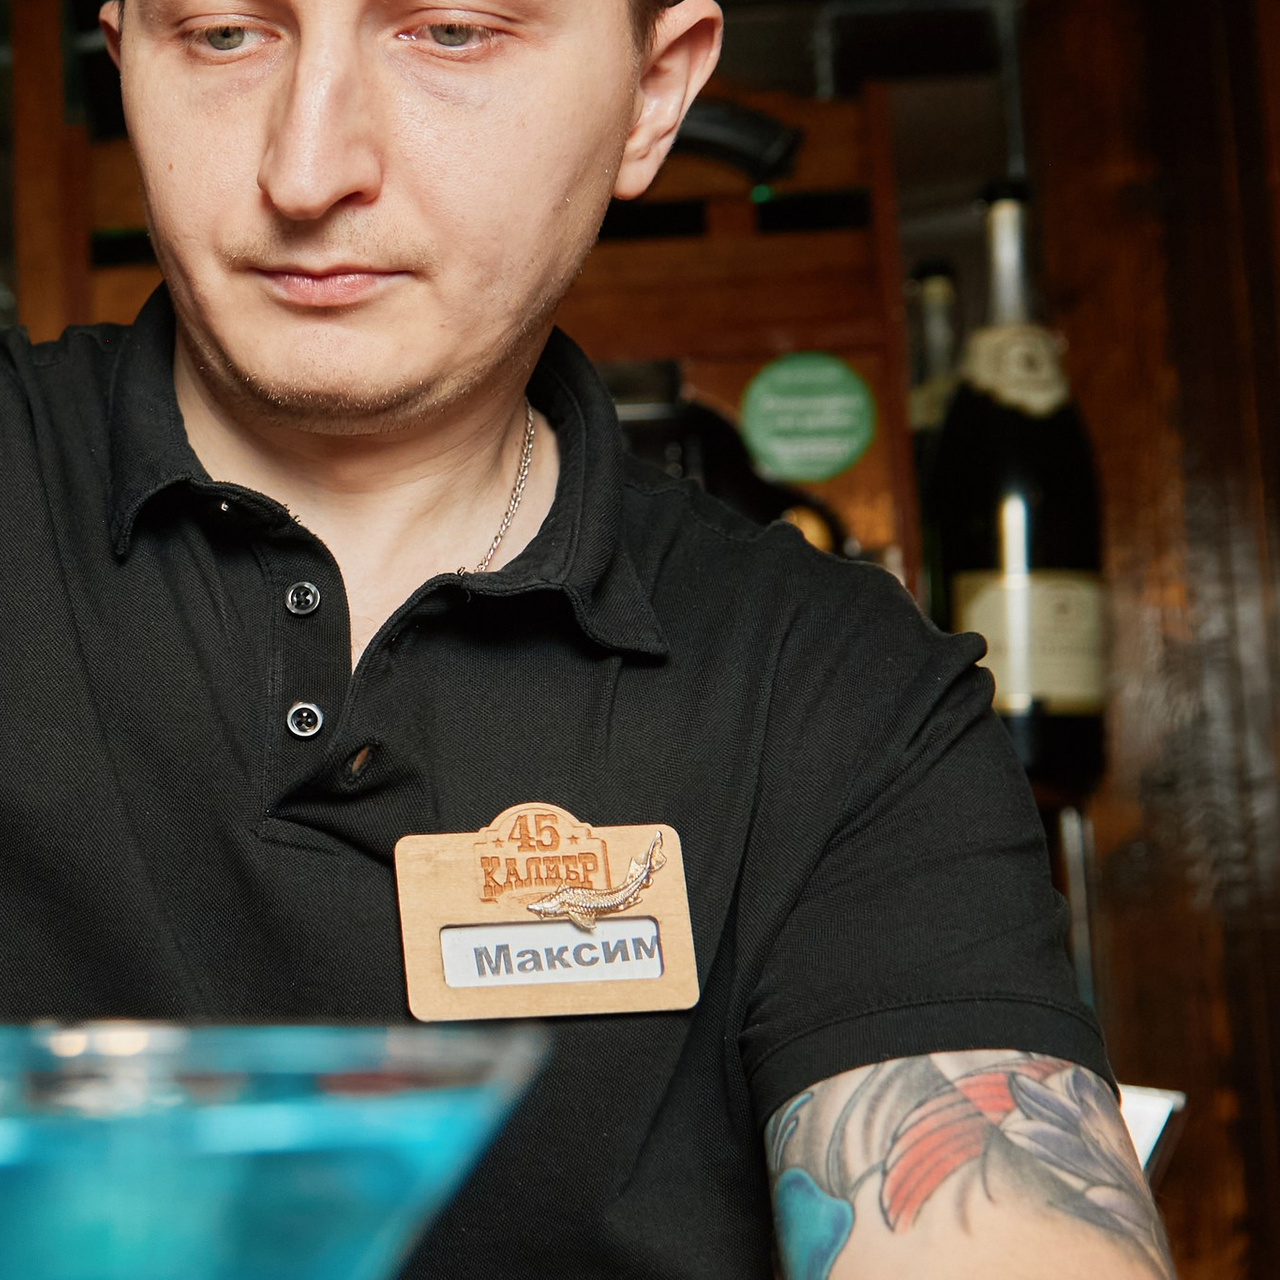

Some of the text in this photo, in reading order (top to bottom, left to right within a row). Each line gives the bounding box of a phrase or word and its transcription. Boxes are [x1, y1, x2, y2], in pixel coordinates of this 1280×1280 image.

[508, 813, 560, 852] 45
[480, 852, 599, 897] КАЛИБР
[473, 934, 659, 978] Максим
